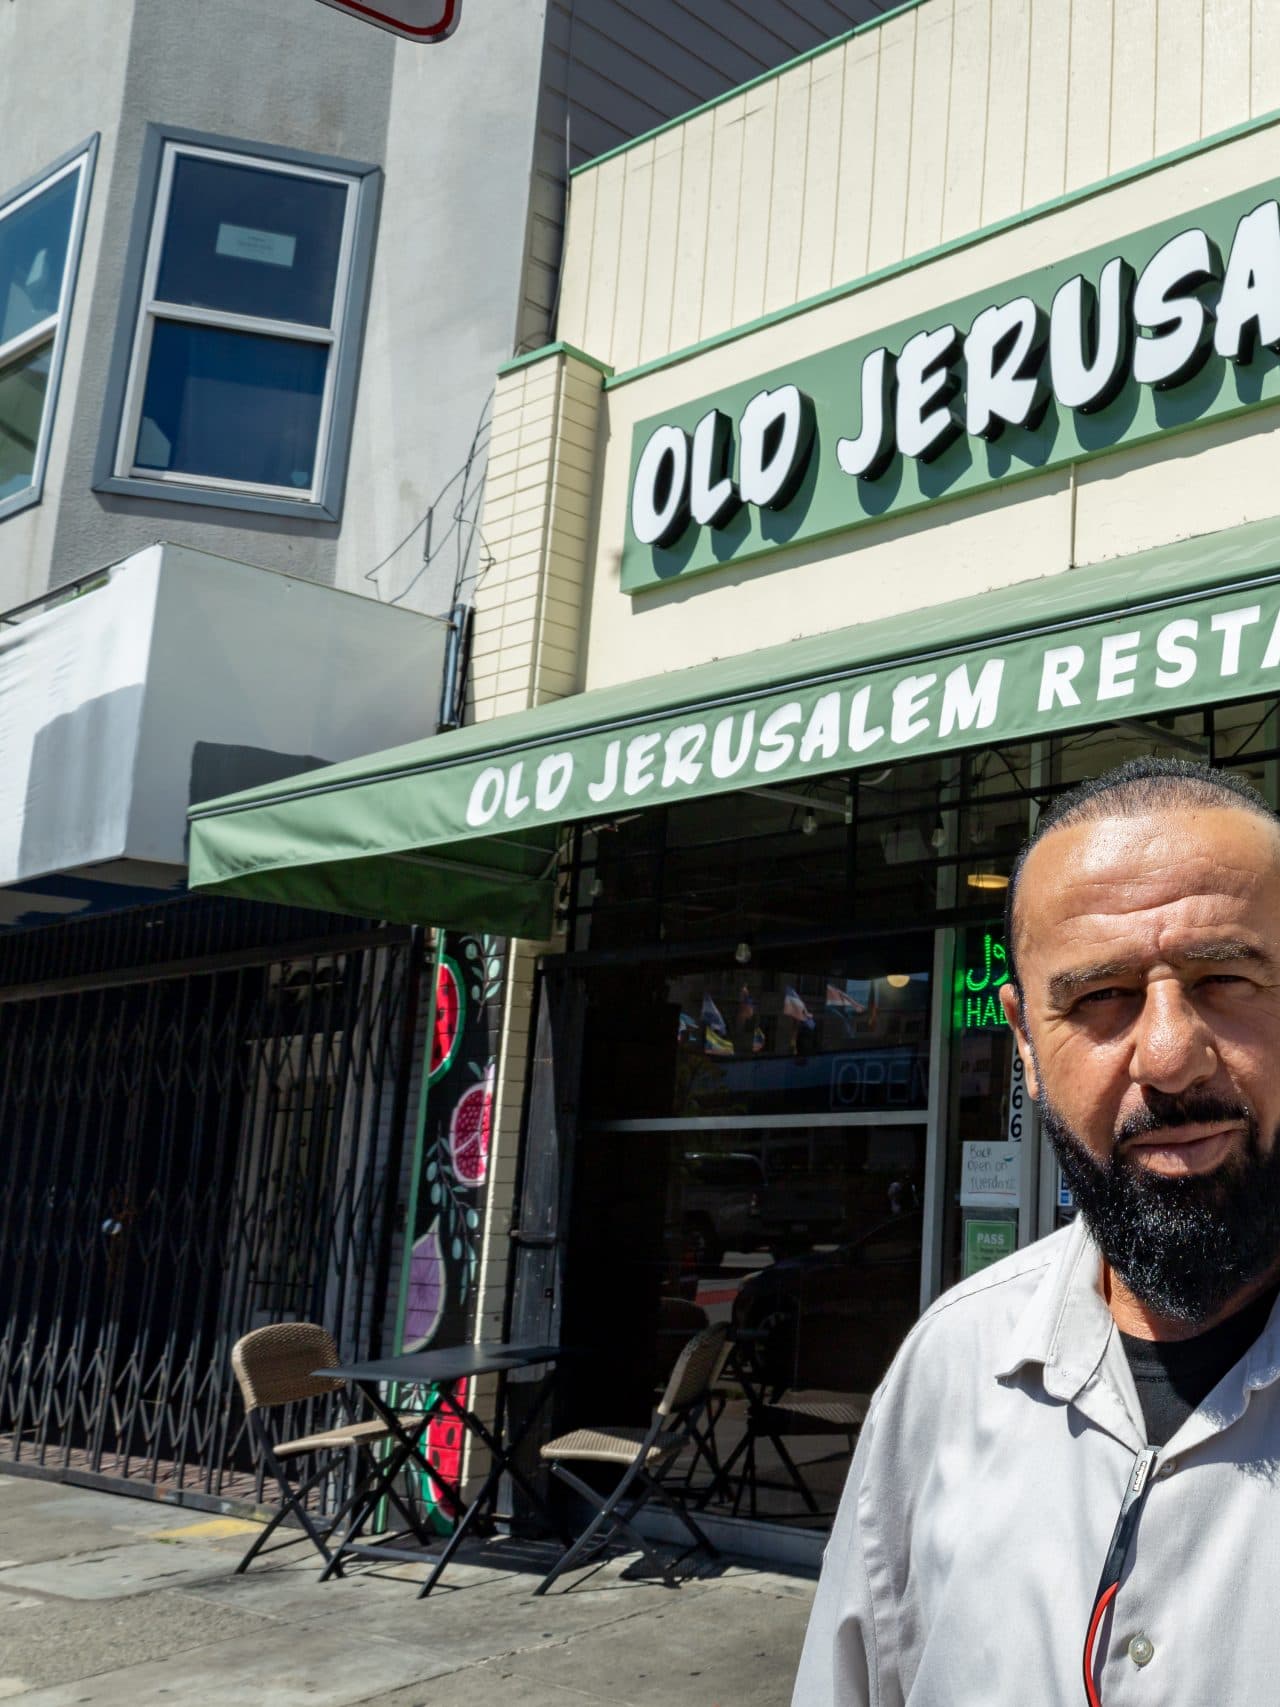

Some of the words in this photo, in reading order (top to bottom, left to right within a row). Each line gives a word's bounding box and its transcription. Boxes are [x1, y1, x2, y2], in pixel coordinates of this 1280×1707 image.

[632, 384, 814, 546] OLD
[466, 752, 574, 826] OLD
[588, 659, 1005, 801] JERUSALEM
[967, 996, 1009, 1027] HAL
[1010, 1045, 1024, 1142] 966
[976, 1232, 1005, 1245] PASS
